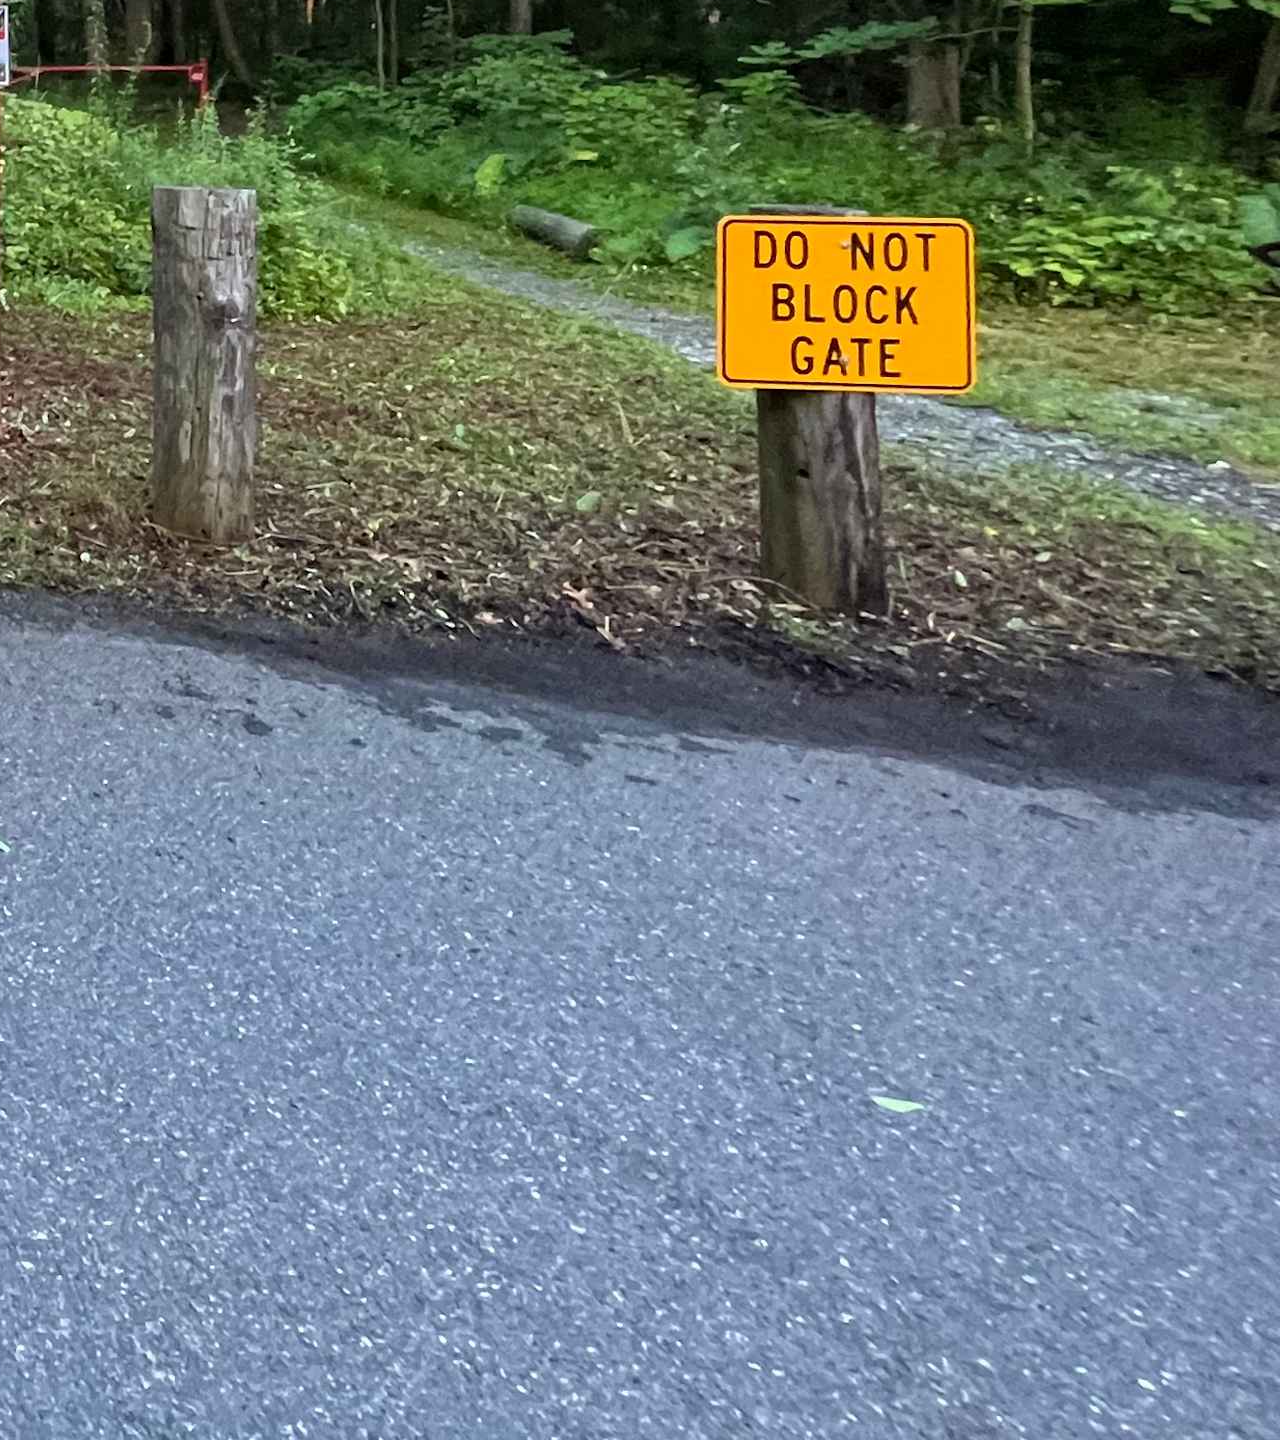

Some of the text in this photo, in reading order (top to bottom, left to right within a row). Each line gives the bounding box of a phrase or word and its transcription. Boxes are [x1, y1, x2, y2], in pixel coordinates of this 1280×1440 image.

[753, 230, 937, 272] DO NOT
[771, 283, 919, 325] BLOCK
[790, 336, 902, 378] GATE
